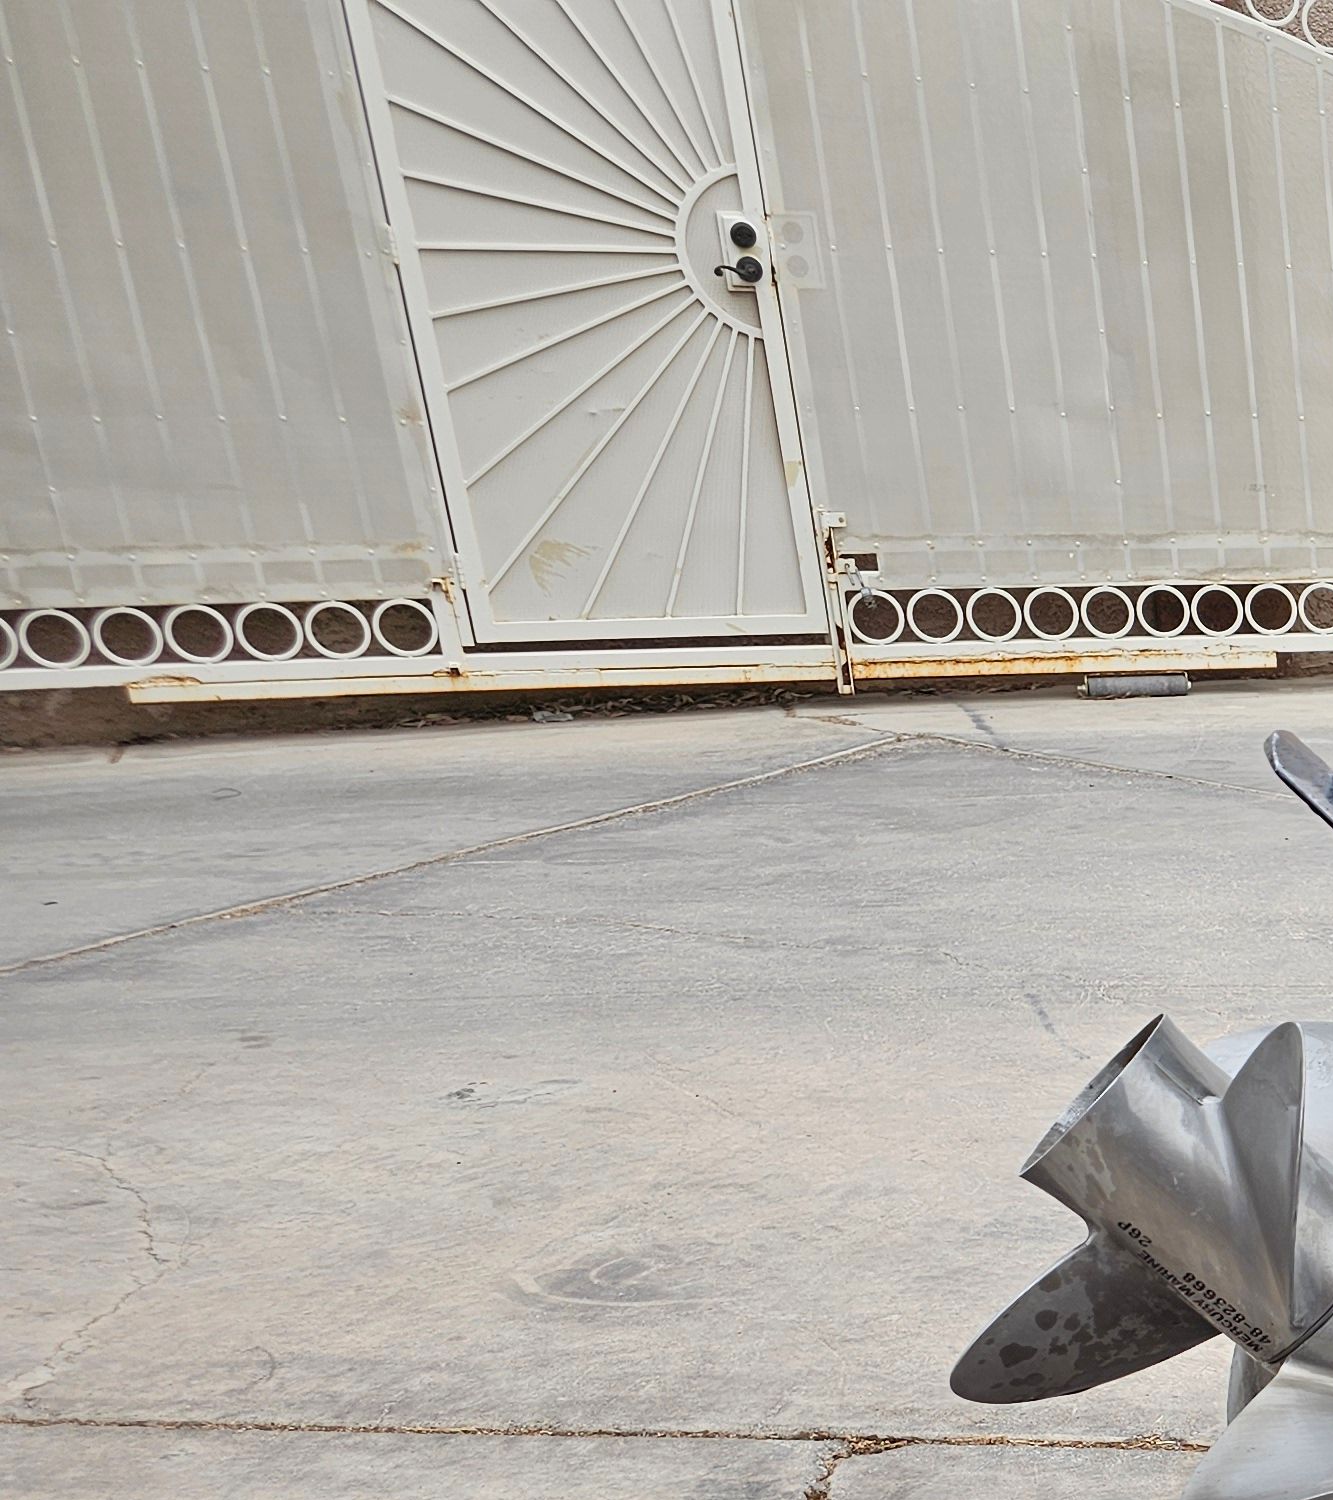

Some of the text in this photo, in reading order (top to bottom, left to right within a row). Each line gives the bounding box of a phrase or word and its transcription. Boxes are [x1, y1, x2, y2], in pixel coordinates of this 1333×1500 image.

[1117, 1221, 1272, 1345] 48-823668 26P
[1138, 1249, 1263, 1352] MERCURY MARINE
